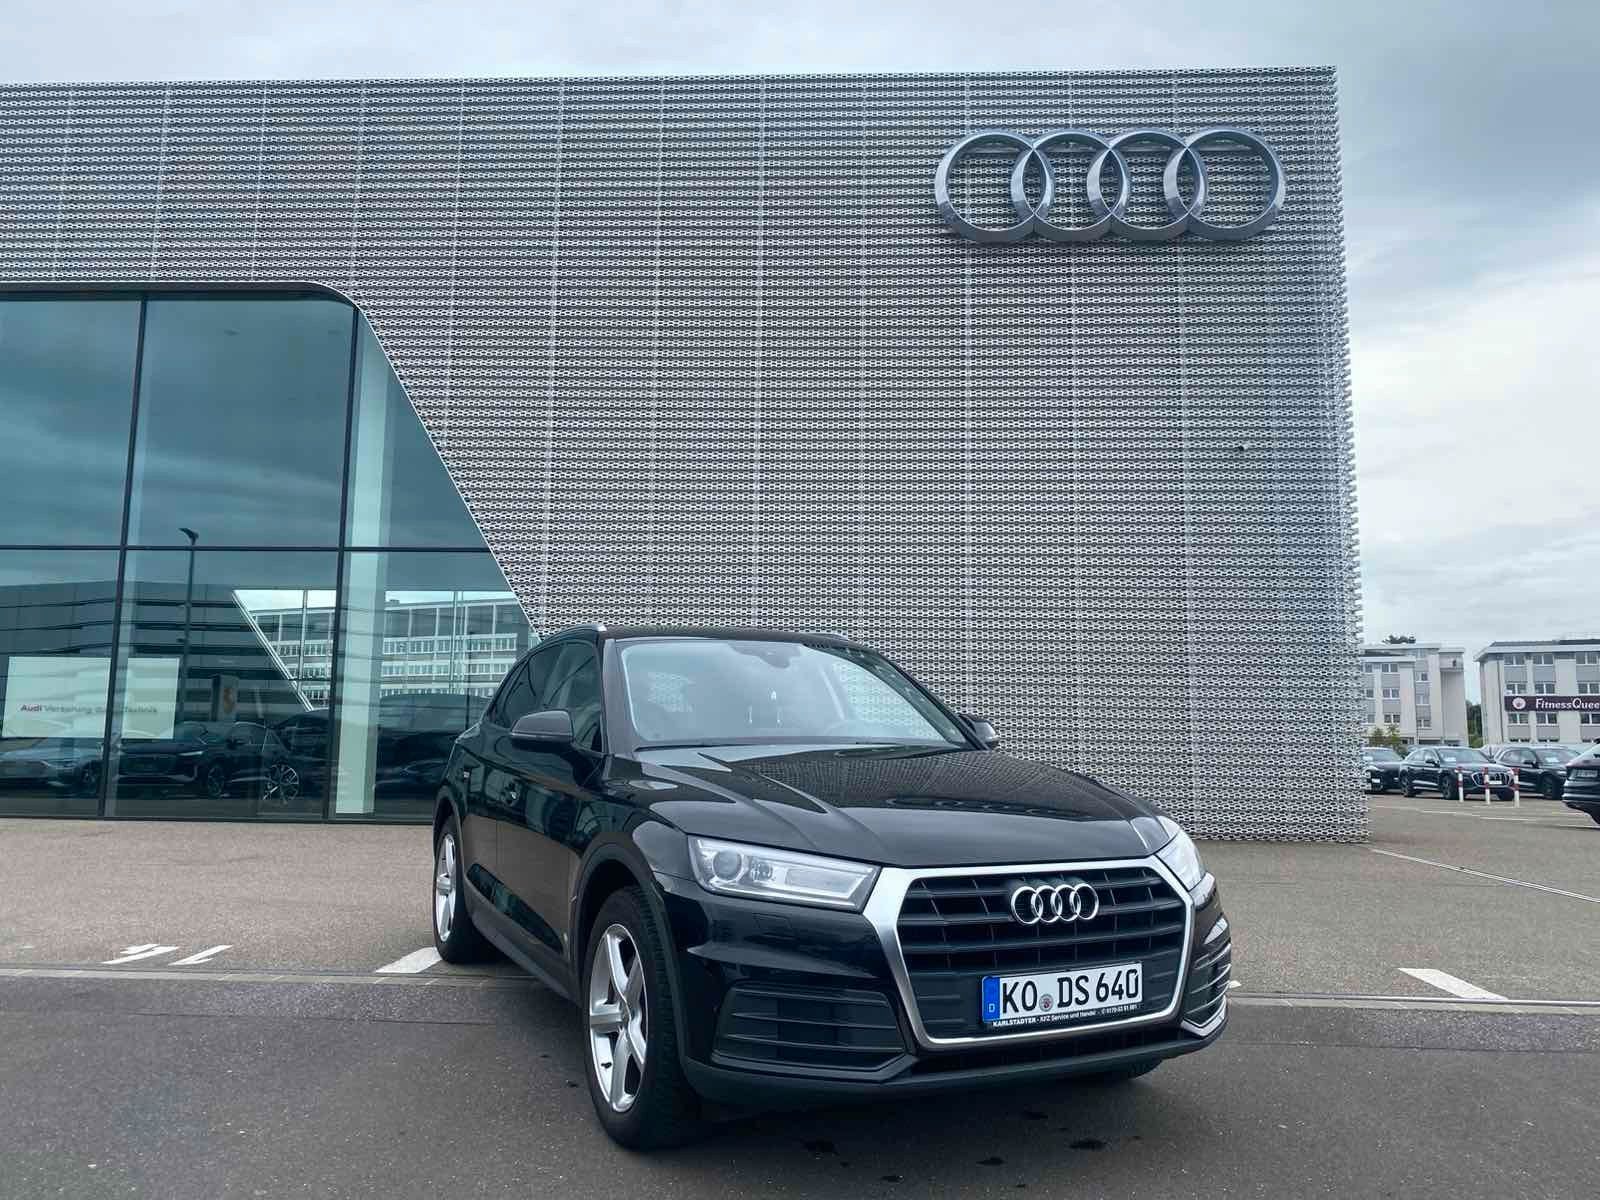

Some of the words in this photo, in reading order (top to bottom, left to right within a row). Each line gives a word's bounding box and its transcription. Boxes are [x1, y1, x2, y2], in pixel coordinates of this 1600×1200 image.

[20, 704, 42, 712] Audi
[1003, 980, 1038, 1014] KO
[1057, 975, 1089, 1008] DS
[1096, 968, 1139, 1002] 640
[988, 1003, 996, 1013] D
[1051, 1012, 1069, 1022] Service
[1069, 1011, 1079, 1019] und
